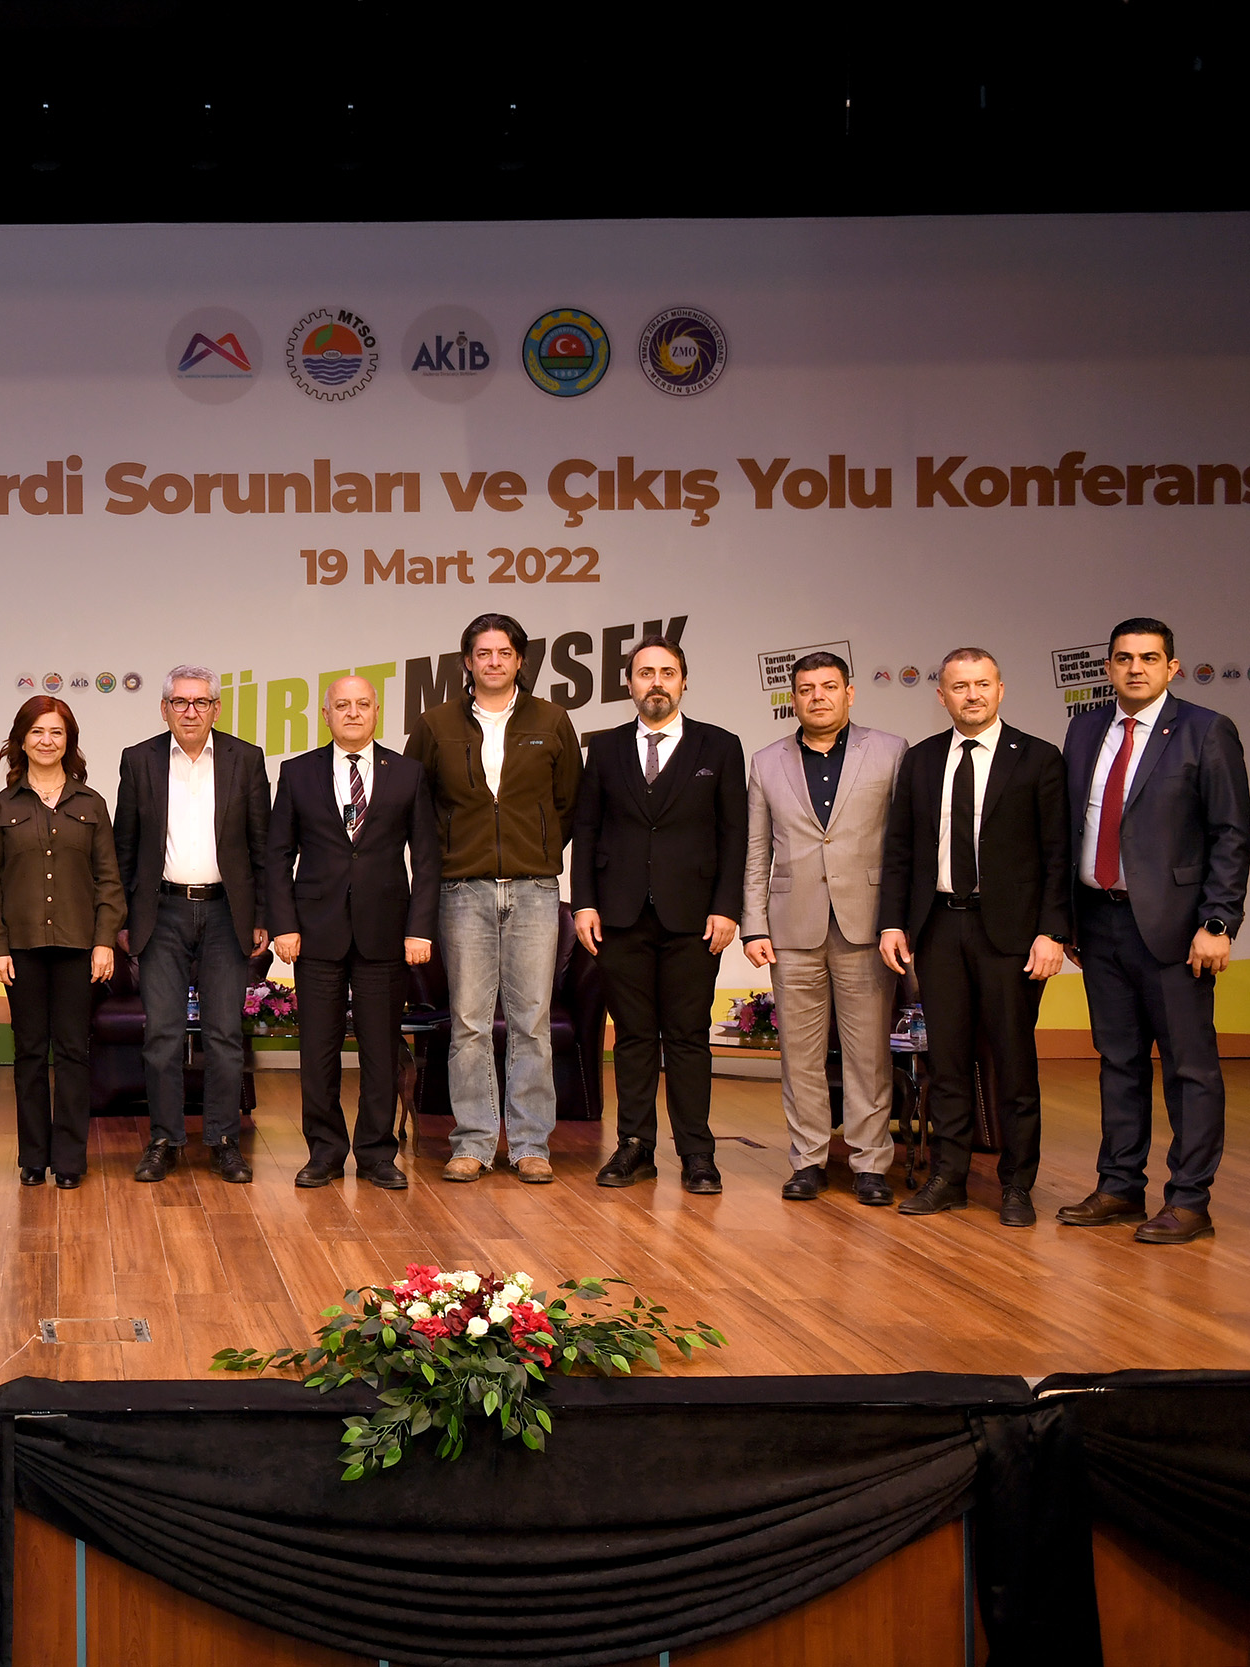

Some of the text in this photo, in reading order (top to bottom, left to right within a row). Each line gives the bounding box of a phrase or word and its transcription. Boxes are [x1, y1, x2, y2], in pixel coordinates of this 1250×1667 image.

[337, 310, 376, 349] MTSO
[641, 310, 724, 364] TMMOB ZİRAAT MÜHENDİSLERİ ODASI
[671, 346, 697, 357] ZMO
[650, 372, 717, 394] MERSİN ŞUBESİ
[106, 459, 421, 515] Sorunları
[442, 472, 527, 513] ve
[549, 457, 721, 528] Çıkış
[740, 456, 892, 510] Yolu
[918, 451, 1250, 507] Konferan
[301, 547, 601, 585] 19 Mart 2022
[764, 654, 796, 665] Tarımda
[1058, 651, 1090, 662] Tarımda
[766, 664, 784, 675] Girdi
[1060, 661, 1078, 672] Girdi
[767, 675, 786, 686] Çıkış
[1061, 672, 1080, 683] Çıkış
[1082, 669, 1098, 678] Yolu
